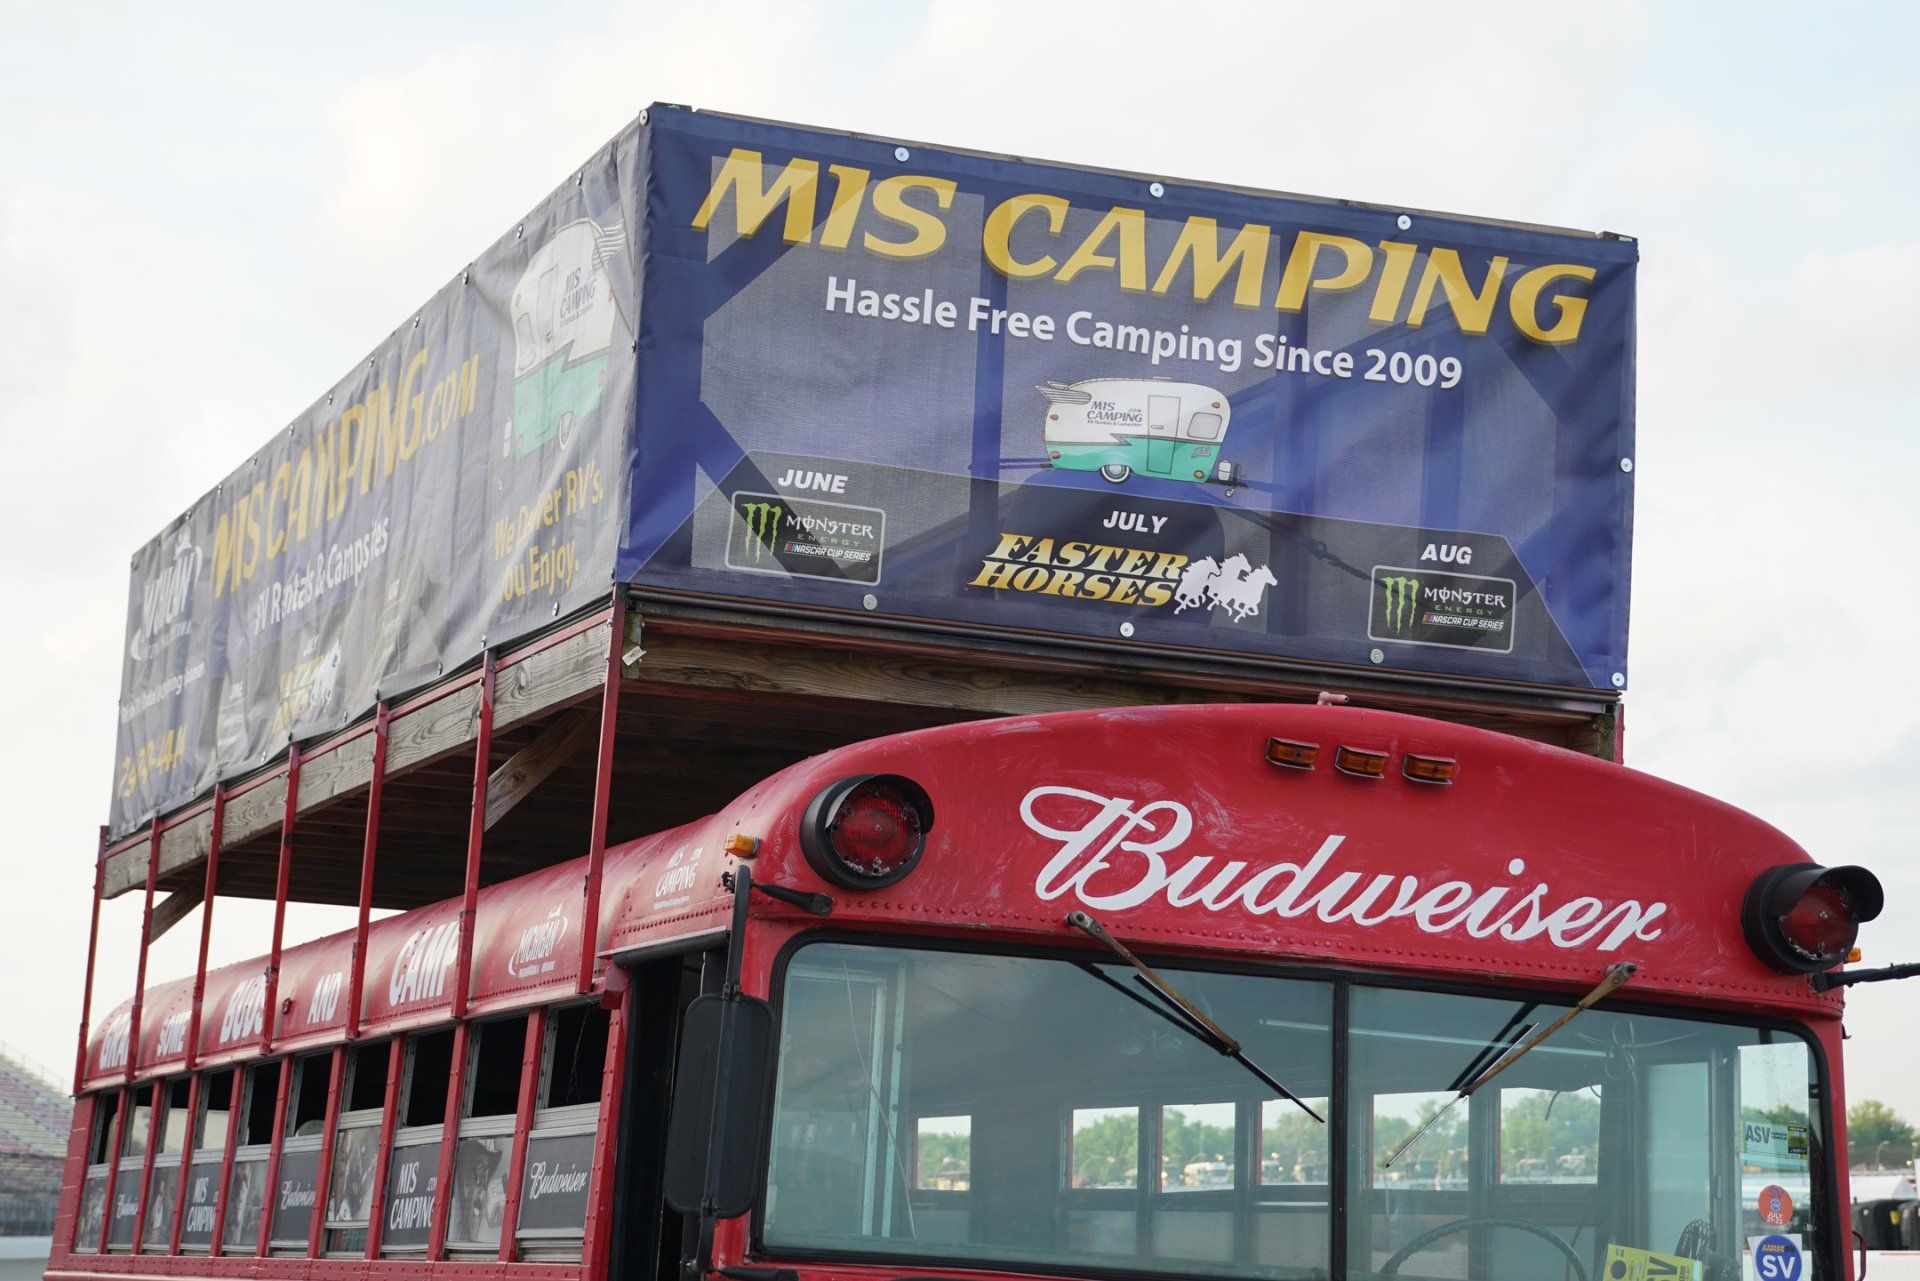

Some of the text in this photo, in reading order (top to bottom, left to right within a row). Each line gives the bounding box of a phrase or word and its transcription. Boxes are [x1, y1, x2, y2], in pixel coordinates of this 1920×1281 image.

[691, 147, 1596, 343] MIS CAMPING
[826, 276, 1462, 389] Hassle Free Camping Since 2009
[1087, 410, 1143, 423] CAMPING
[1091, 401, 1115, 411] MIS
[778, 469, 848, 494] JUNE
[786, 515, 874, 539] MONSTER
[1103, 510, 1168, 535] JULY
[797, 533, 860, 547] ENERGY
[793, 545, 871, 561] NASCAR CUP SERIES
[986, 532, 1191, 578] FASTER
[1420, 543, 1472, 565] AUG
[529, 536, 580, 597] Enjoy.
[967, 560, 1182, 608] HORSES
[1424, 587, 1506, 608] MONSTER
[1434, 604, 1494, 616] ENERGY
[1432, 615, 1505, 630] NASCAR CUP SERIES
[655, 862, 699, 898] CAMPING
[1019, 785, 1667, 951] Budweiser
[307, 971, 343, 1025] AND
[389, 920, 459, 1007] CAMP
[1744, 1124, 1771, 1144] ASV
[397, 1161, 420, 1195] MIS
[530, 1161, 588, 1200] Budweiser
[1762, 1254, 1796, 1280] SV
